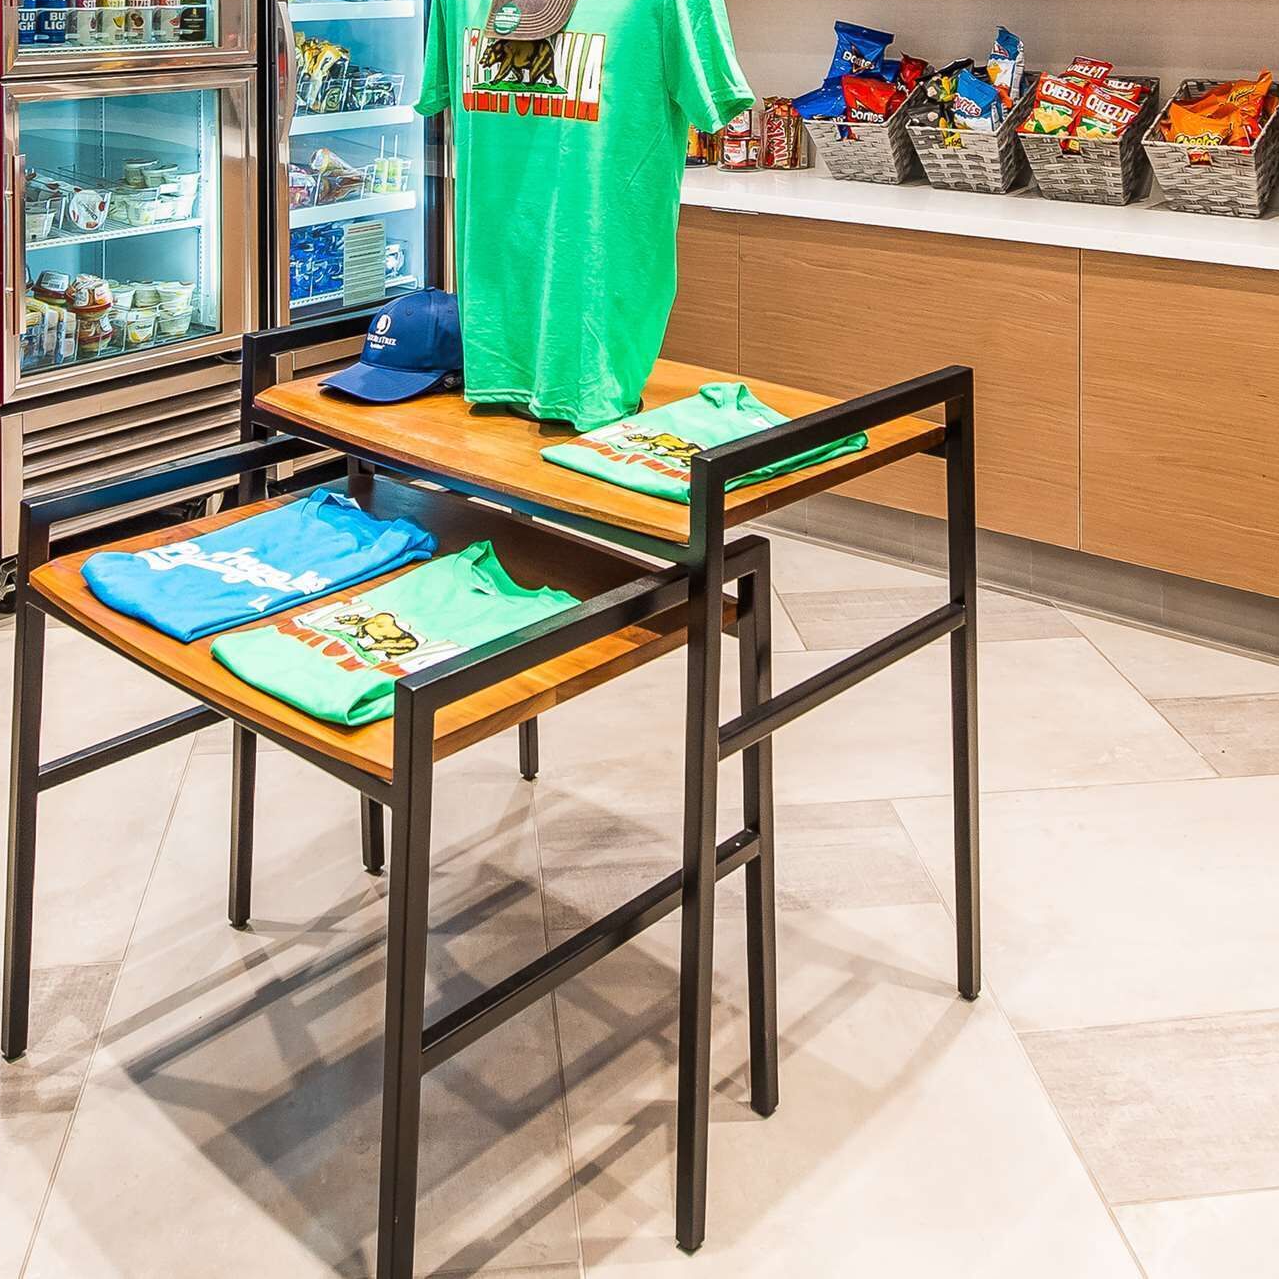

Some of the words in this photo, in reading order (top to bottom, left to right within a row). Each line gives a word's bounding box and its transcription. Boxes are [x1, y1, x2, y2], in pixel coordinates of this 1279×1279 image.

[50, 11, 66, 21] BU
[44, 21, 66, 30] LIG
[842, 50, 875, 70] Doritos
[463, 27, 606, 122] CANIA
[851, 109, 884, 123] Doritos
